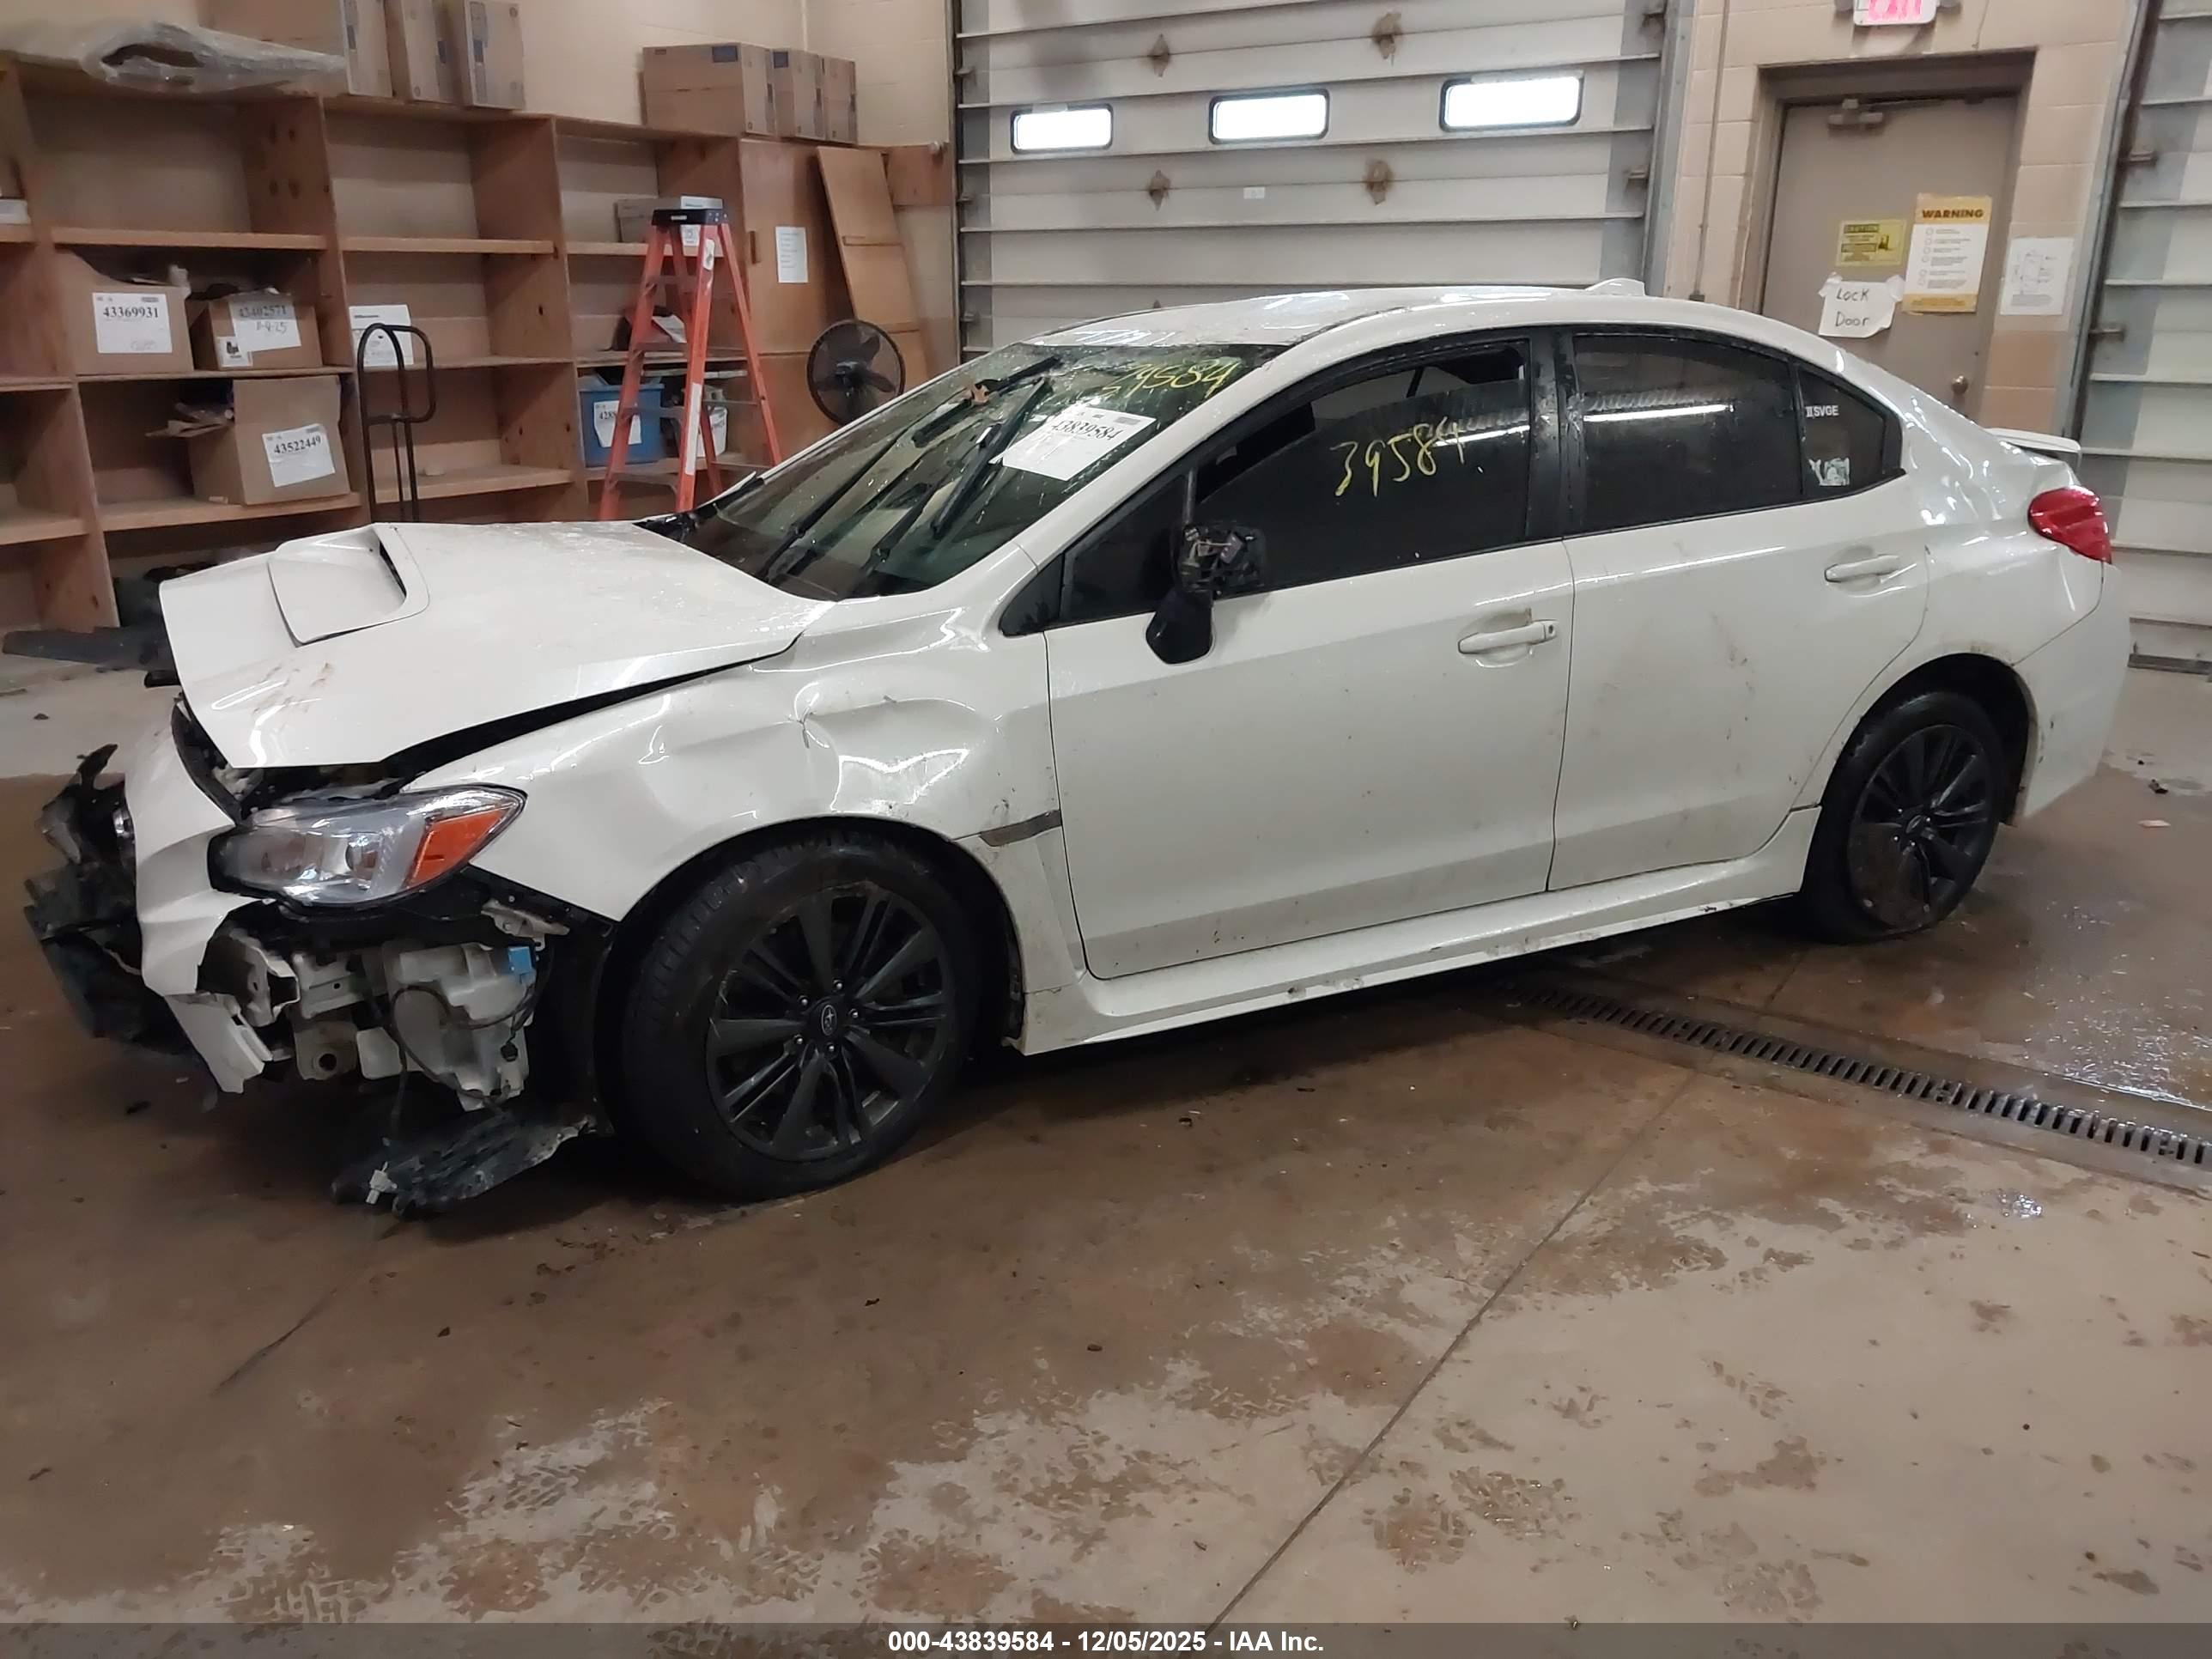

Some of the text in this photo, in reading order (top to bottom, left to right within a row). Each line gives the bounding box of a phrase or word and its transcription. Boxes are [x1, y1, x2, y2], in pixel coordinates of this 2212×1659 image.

[1922, 209, 1984, 219] WARNING
[102, 306, 159, 319] 43369931
[1835, 311, 1869, 327] Door
[274, 434, 322, 454] 43522449
[1329, 416, 1465, 497] 39584
